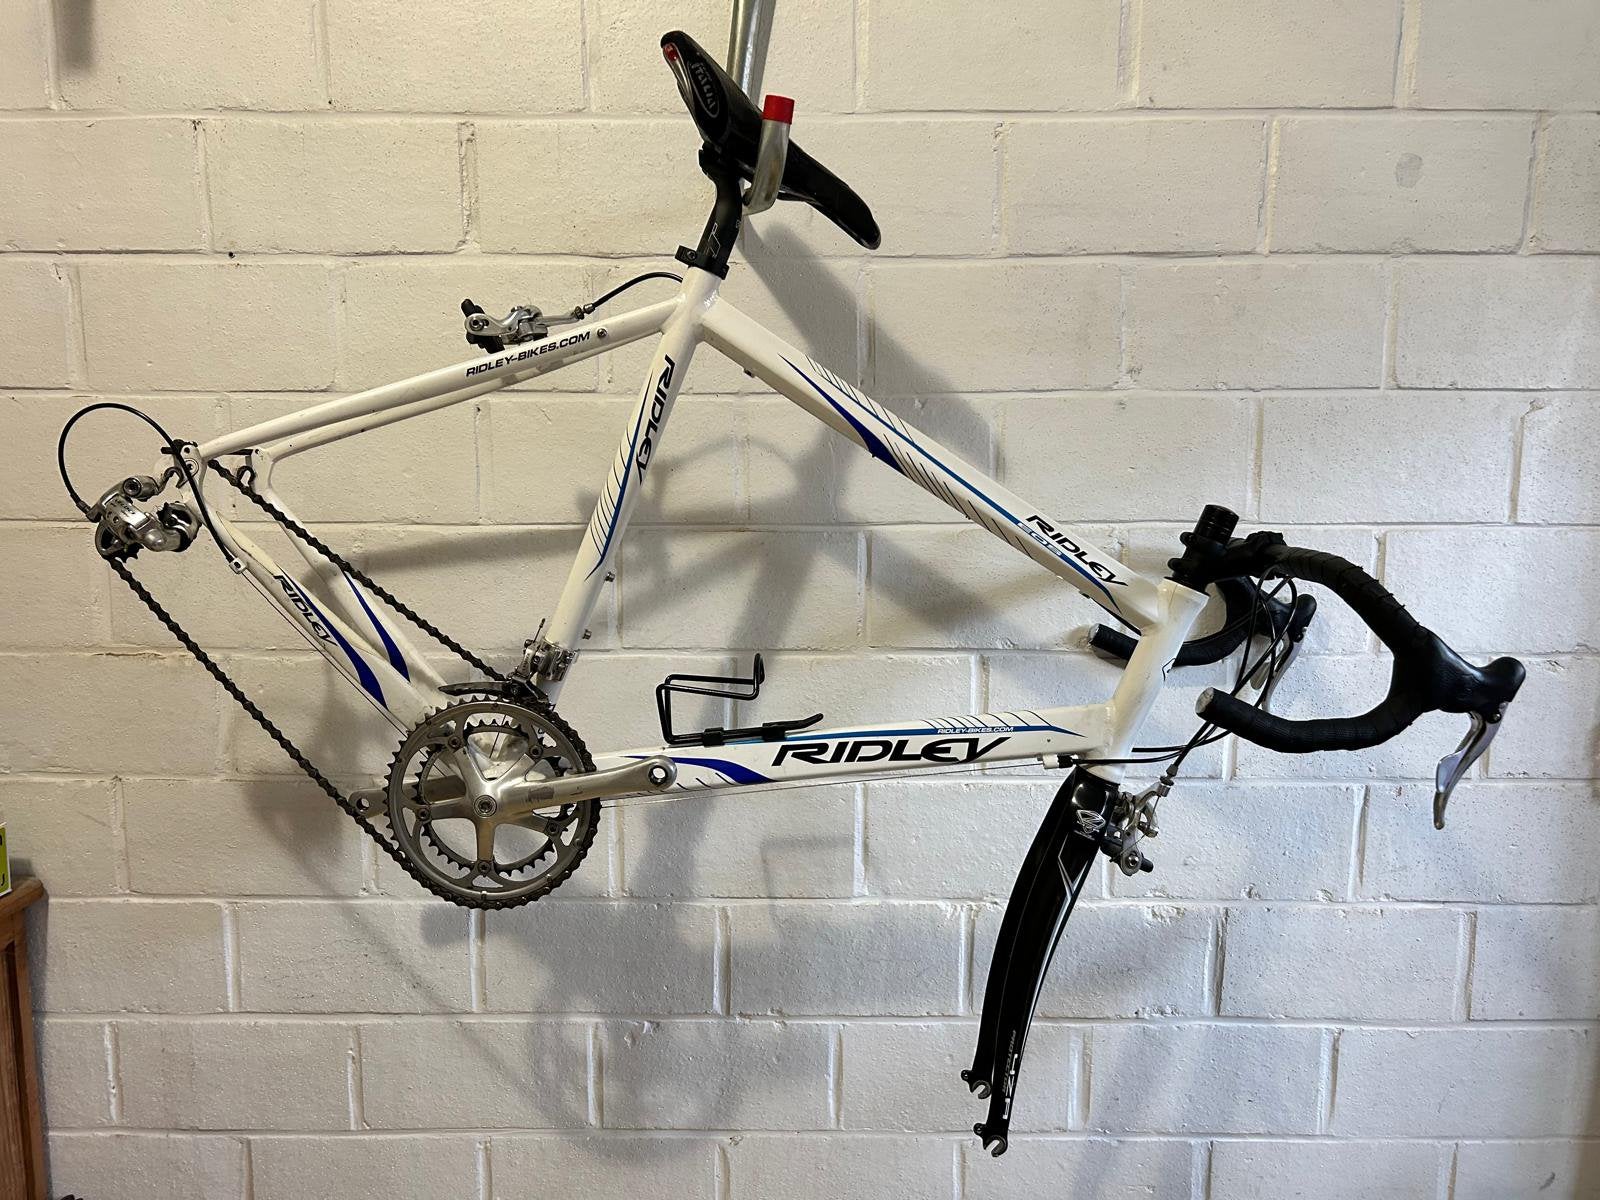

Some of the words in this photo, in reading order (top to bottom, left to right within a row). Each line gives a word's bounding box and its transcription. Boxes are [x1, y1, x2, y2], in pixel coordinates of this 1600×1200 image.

[466, 331, 590, 377] RIDLEY-BIKES.COM
[636, 354, 675, 485] RIDLEY
[1026, 515, 1128, 586] RIDLEY
[273, 575, 338, 647] RIDLEY
[772, 736, 1011, 766] RIDLEY
[937, 726, 1014, 734] RIDLEY-BIKES.COM
